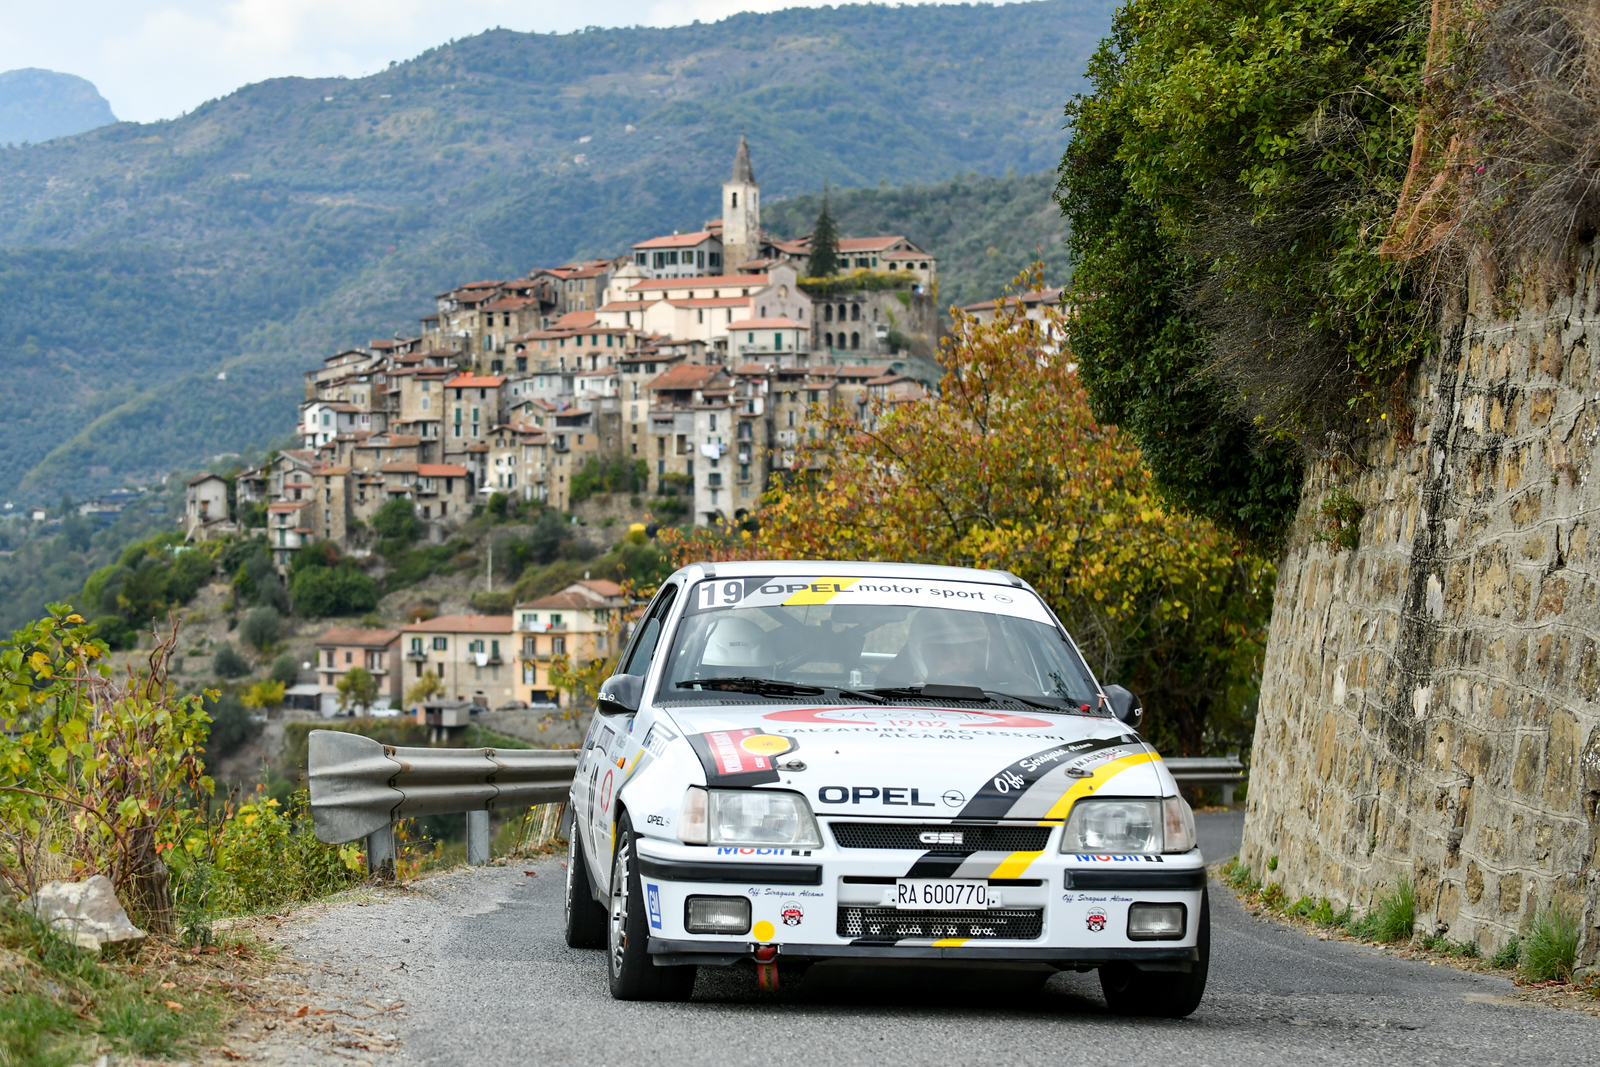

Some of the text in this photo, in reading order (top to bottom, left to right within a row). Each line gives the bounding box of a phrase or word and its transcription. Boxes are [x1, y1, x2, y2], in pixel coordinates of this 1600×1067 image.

[701, 582, 744, 606] 19
[760, 583, 986, 601] OPEL motor sport
[885, 719, 950, 729] 1902
[778, 727, 908, 735] CALZATURE
[942, 728, 1066, 741] ACCESSORI
[879, 733, 974, 741] ALCAMO
[993, 769, 1025, 794] Off.
[818, 786, 936, 807] OPEL
[647, 814, 665, 827] OPEL
[898, 883, 986, 905] RA 600770
